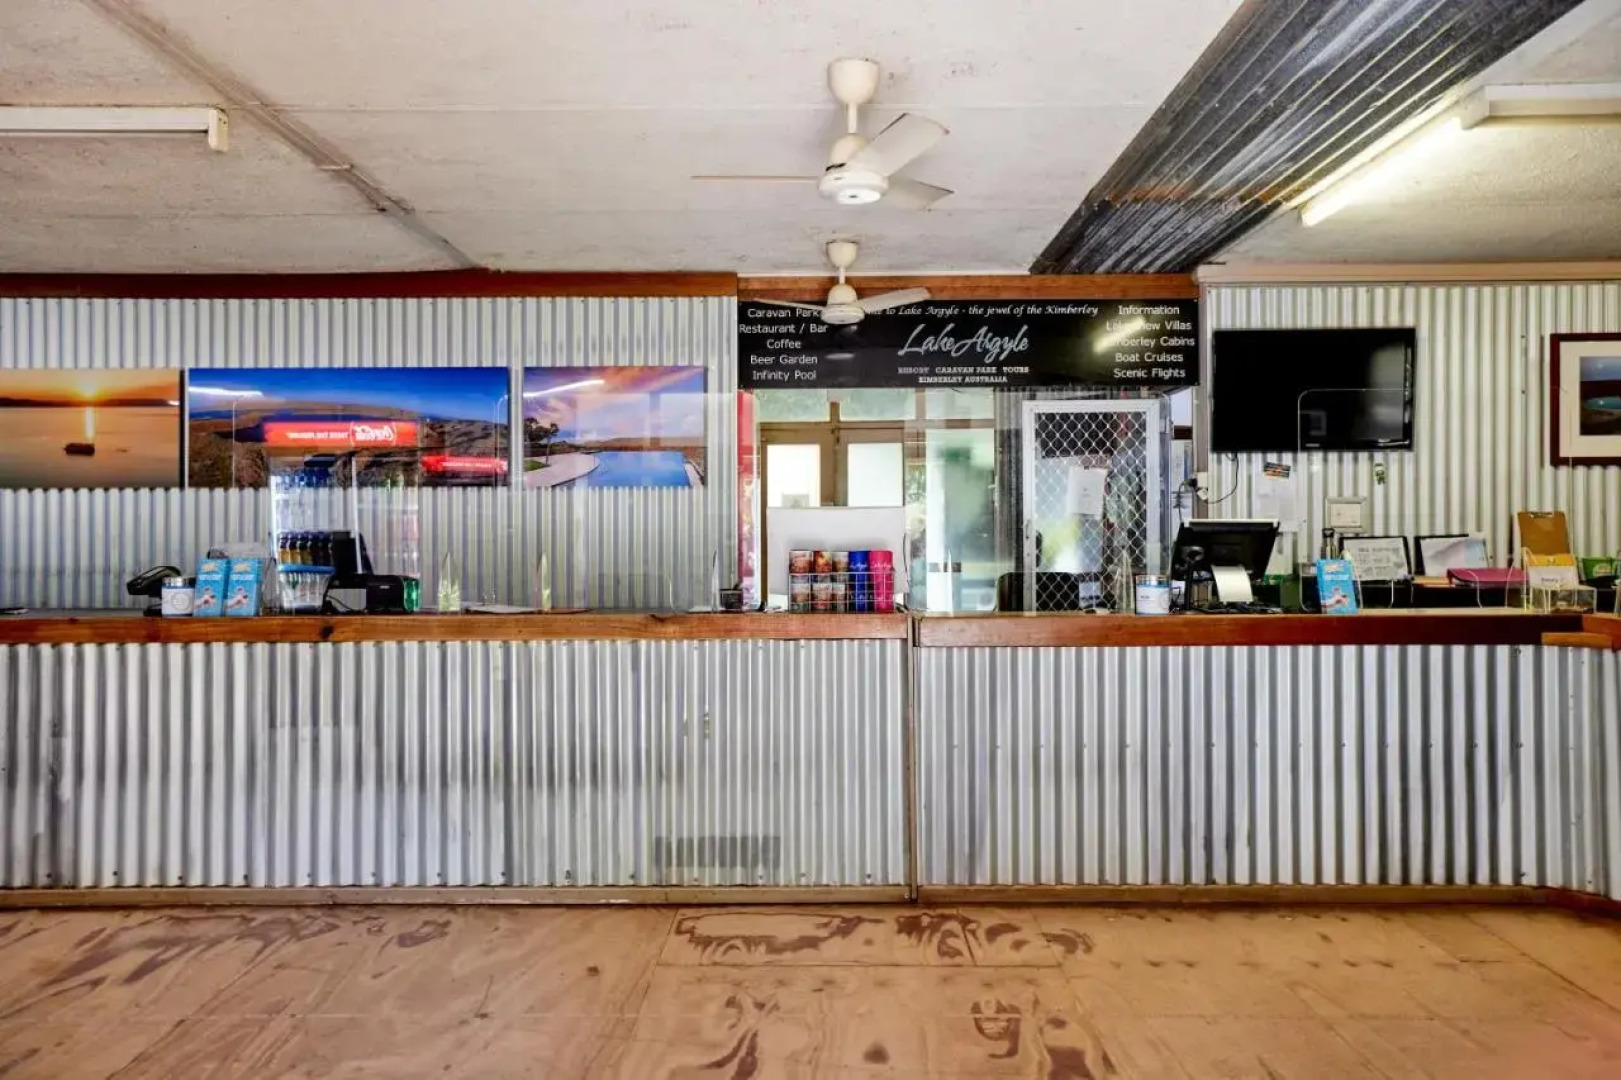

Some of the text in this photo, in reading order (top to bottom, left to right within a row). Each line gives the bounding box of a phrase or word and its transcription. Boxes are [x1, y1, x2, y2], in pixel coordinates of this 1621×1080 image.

[747, 308, 820, 317] Caravan Park
[898, 305, 923, 315] Lake
[925, 305, 960, 317] Argyle
[968, 305, 984, 315] the
[985, 305, 1013, 317] jewel
[1013, 305, 1026, 317] of
[1026, 305, 1043, 315] the
[1044, 305, 1099, 317] Kimberley
[1118, 305, 1180, 315] Information
[739, 323, 828, 334] Restaurant / Bar
[1164, 320, 1193, 330] Villas
[766, 339, 802, 349] Coffee
[897, 323, 1029, 363] Lake Argyle
[1159, 336, 1195, 346] Cabins
[750, 354, 818, 364] Beer Garden
[1115, 353, 1184, 362] Boat Cruises
[935, 366, 974, 374] CARAVAN
[975, 366, 997, 374] PARK
[1002, 366, 1030, 374] TOURS
[1113, 368, 1186, 380] Scenic Flights
[752, 370, 817, 381] Infinity Pool
[918, 375, 1008, 384] KIMBERLEY AUSTRALIA
